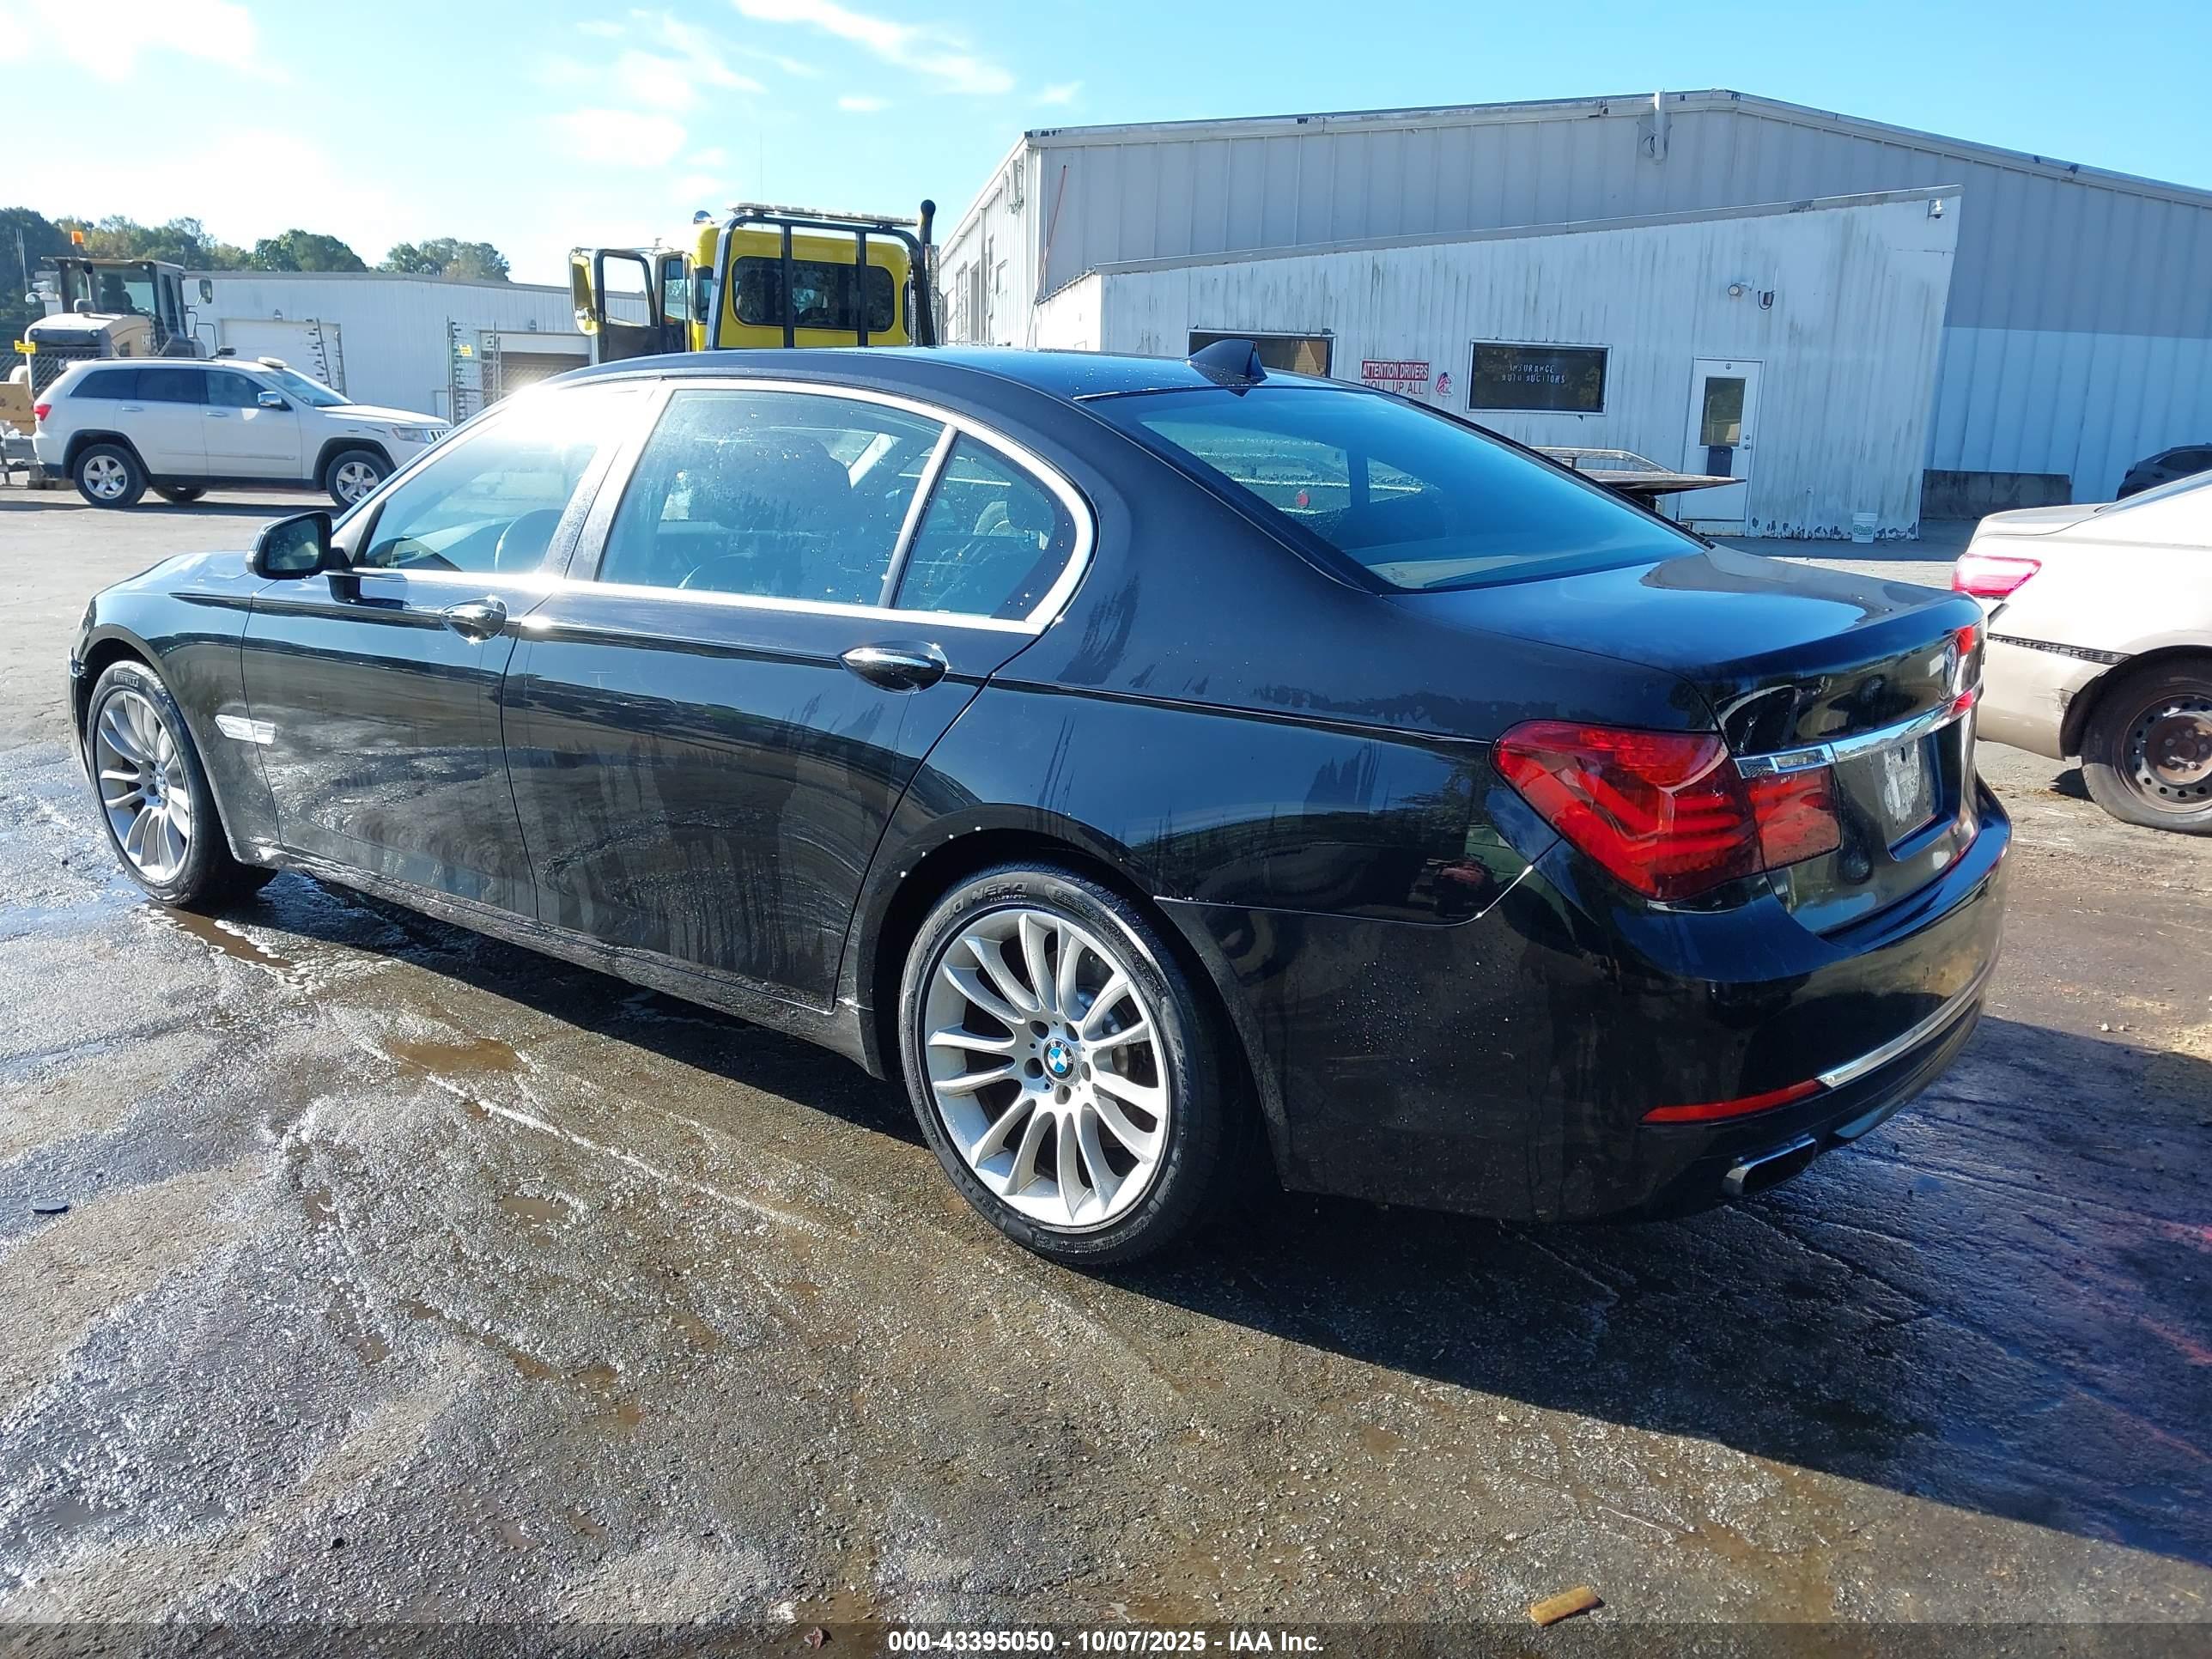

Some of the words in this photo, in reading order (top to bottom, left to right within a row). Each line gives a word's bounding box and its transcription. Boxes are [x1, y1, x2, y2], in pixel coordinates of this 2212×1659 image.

[1362, 362, 1399, 379] ATTENTION
[1400, 364, 1428, 380] DRIVERS
[1392, 381, 1404, 393] UP
[1407, 382, 1424, 395] ALL
[1049, 1040, 1073, 1064] BMW
